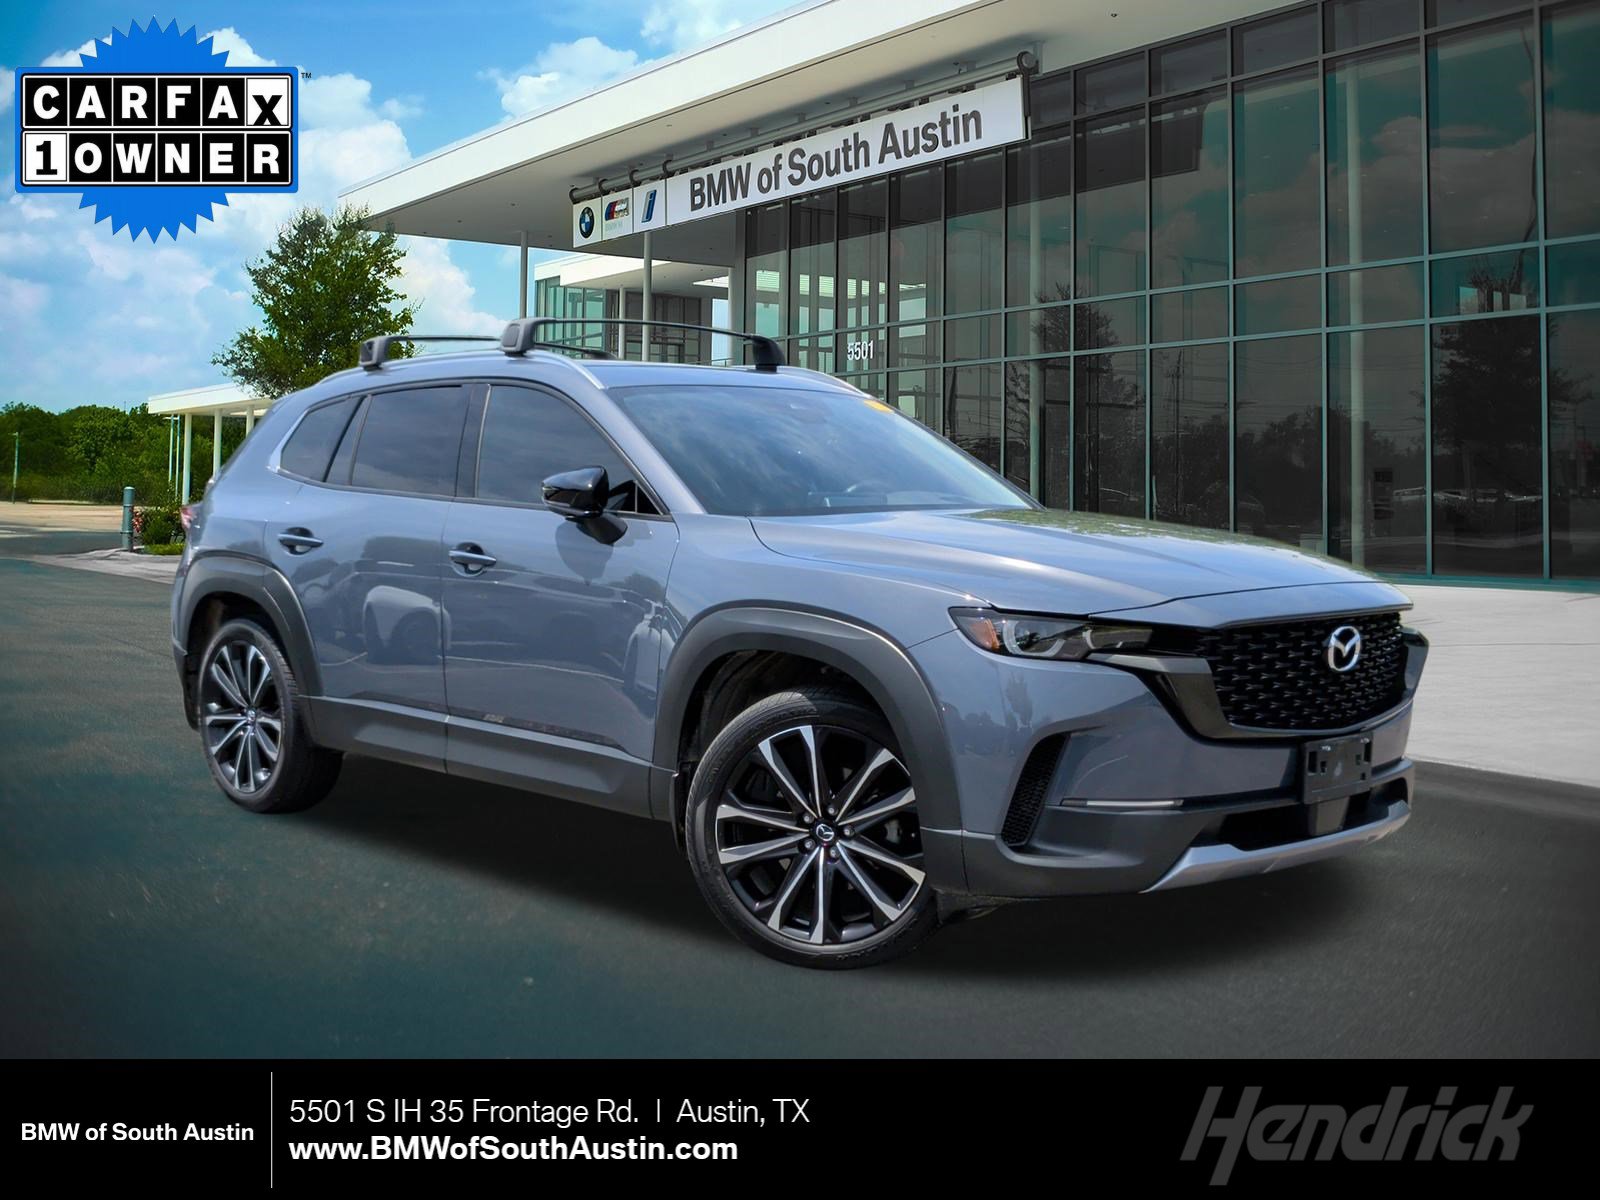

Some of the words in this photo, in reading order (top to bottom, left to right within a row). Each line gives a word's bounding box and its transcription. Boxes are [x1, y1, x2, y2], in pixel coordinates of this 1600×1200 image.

[690, 161, 752, 212] BMW
[757, 153, 782, 194] of
[787, 131, 870, 186] South
[878, 103, 982, 164] Austin
[847, 339, 874, 360] 5501
